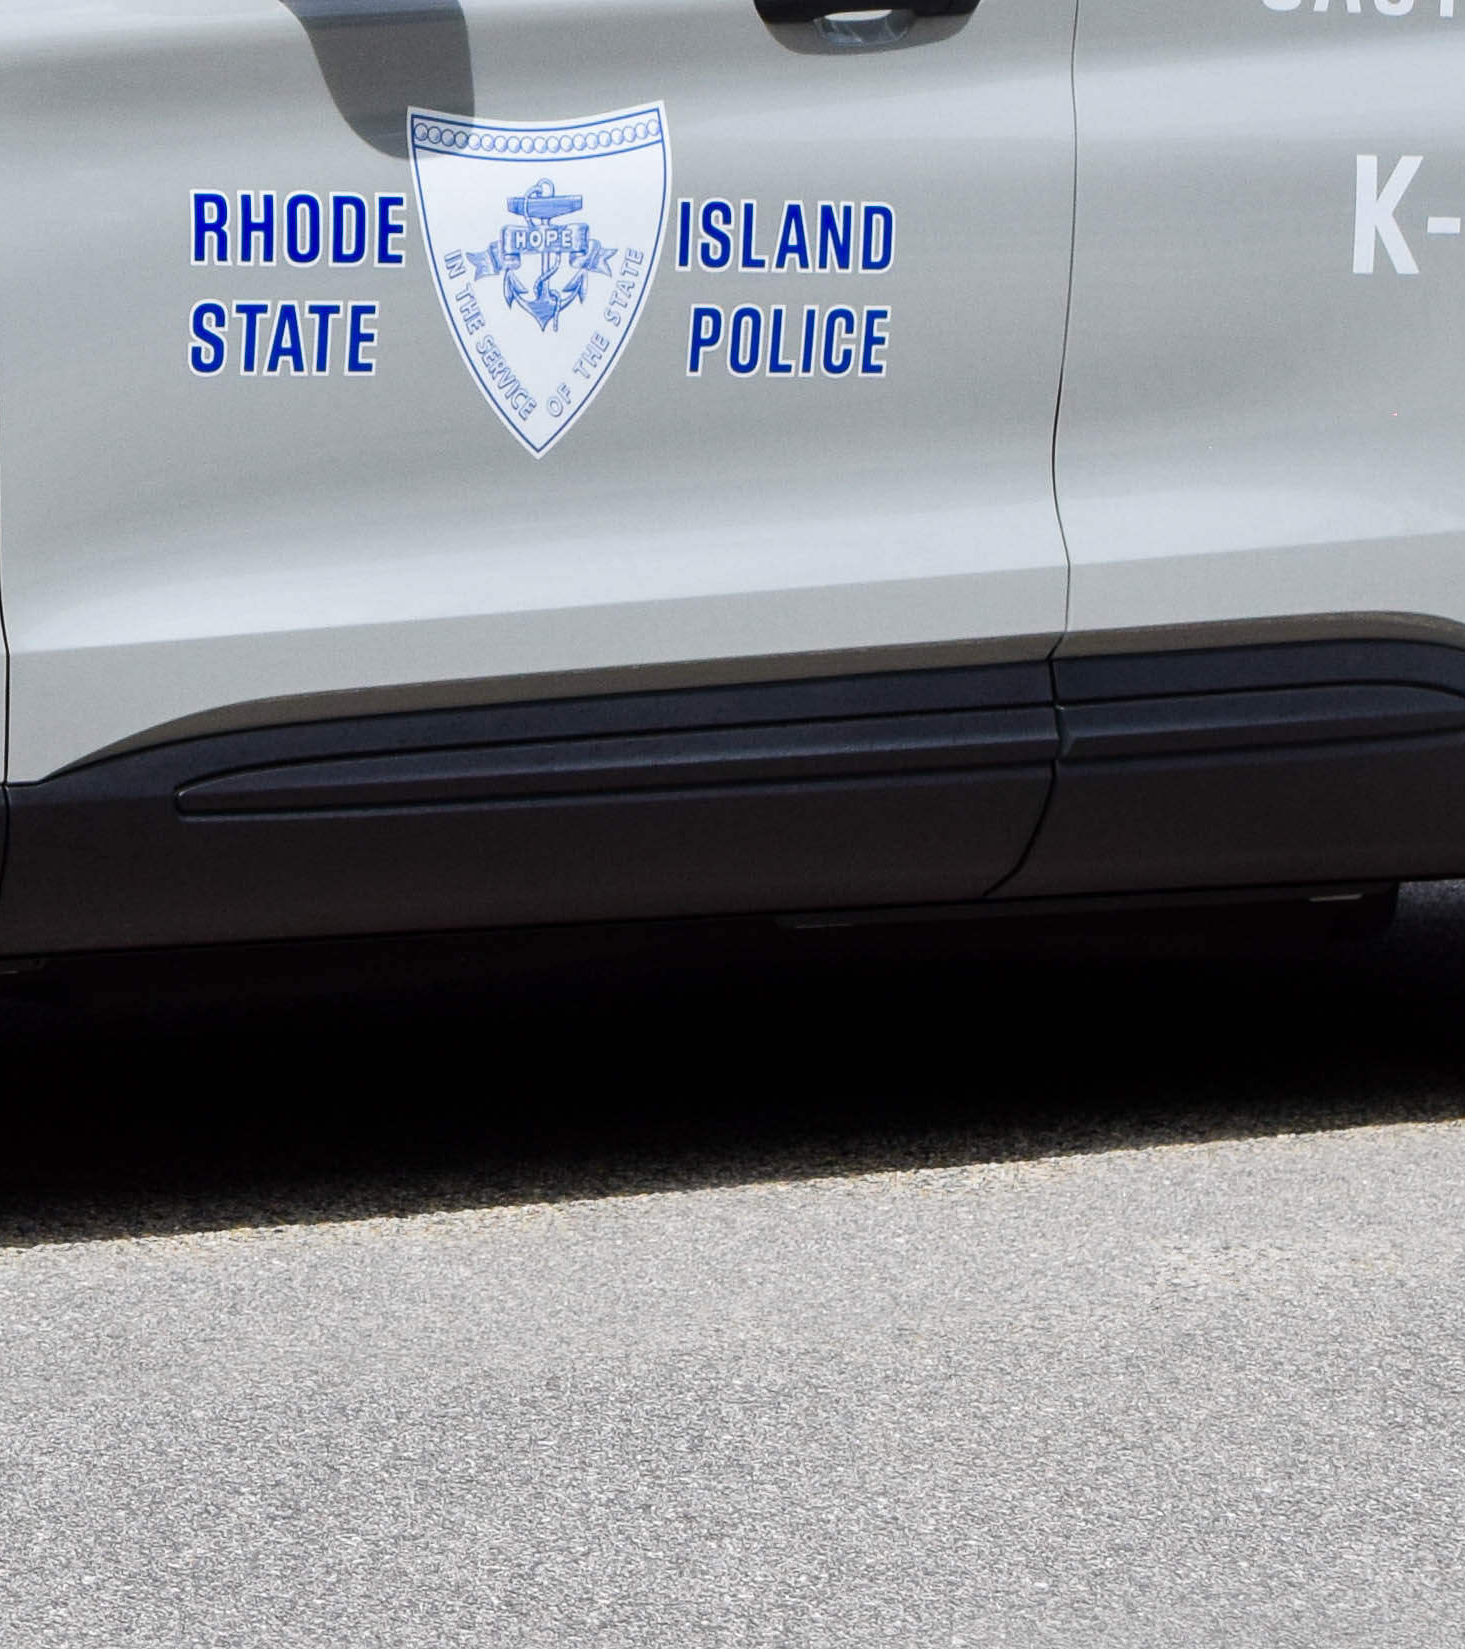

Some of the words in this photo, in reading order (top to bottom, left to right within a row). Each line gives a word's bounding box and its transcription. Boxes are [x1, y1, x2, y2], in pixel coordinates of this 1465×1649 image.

[190, 189, 407, 267] RHODE
[676, 199, 896, 273] ISLAND
[514, 229, 574, 250] HOPE
[188, 298, 379, 377] STATE
[687, 304, 892, 378] POLICE
[443, 248, 467, 280] IN
[455, 282, 486, 336] THE
[475, 334, 538, 421] SERVICE
[546, 382, 573, 418] OF
[573, 331, 610, 380] THE
[604, 248, 645, 327] STATE
